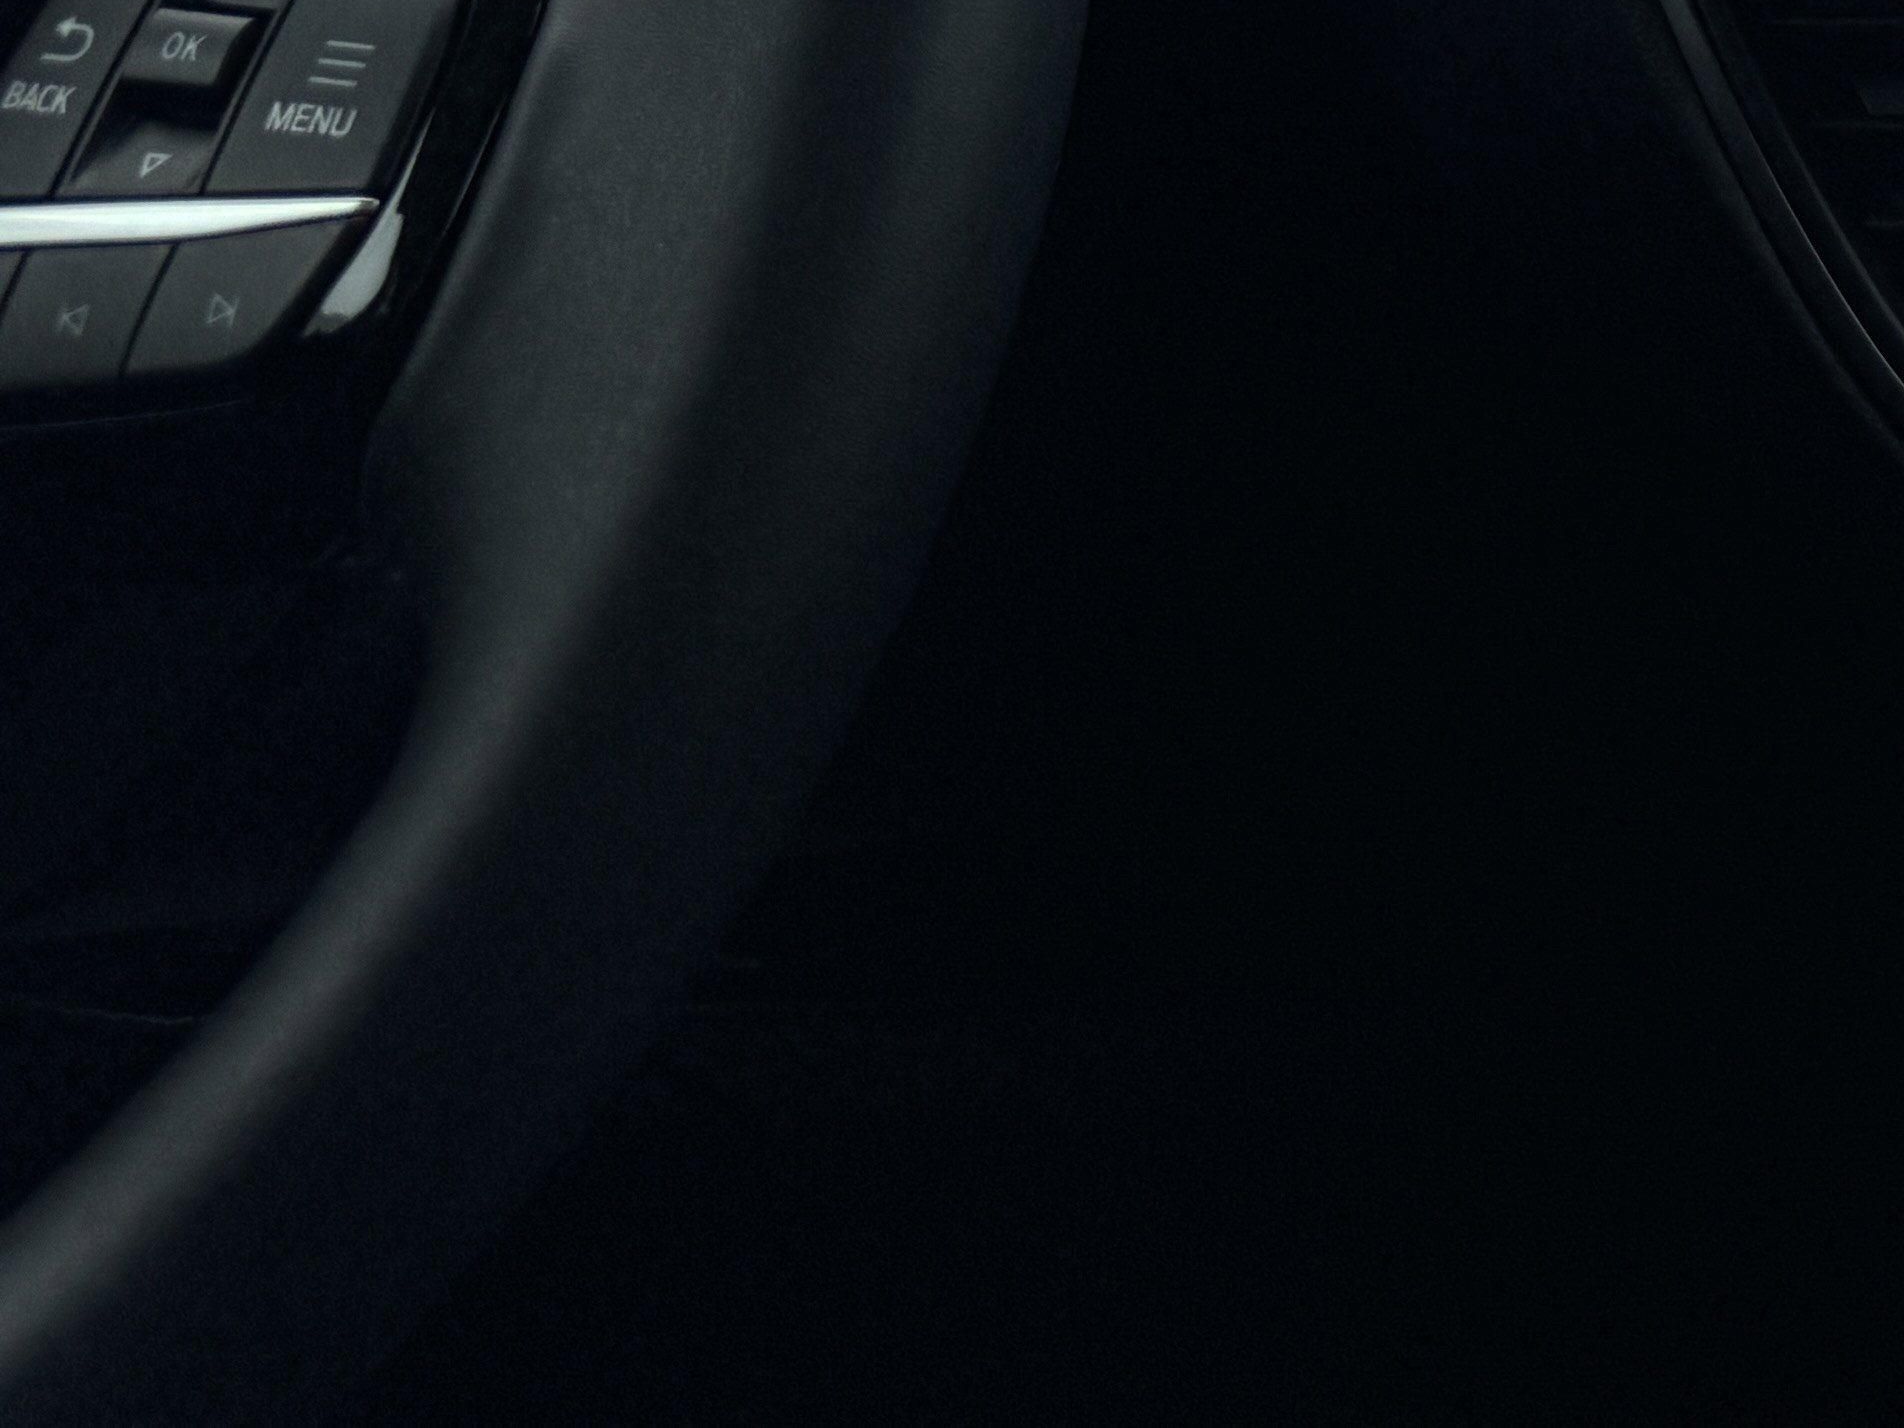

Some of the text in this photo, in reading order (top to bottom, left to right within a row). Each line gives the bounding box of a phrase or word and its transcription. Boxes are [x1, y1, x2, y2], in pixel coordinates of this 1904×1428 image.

[161, 32, 205, 61] OK
[1, 80, 76, 115] BACK
[264, 101, 357, 138] MENU
